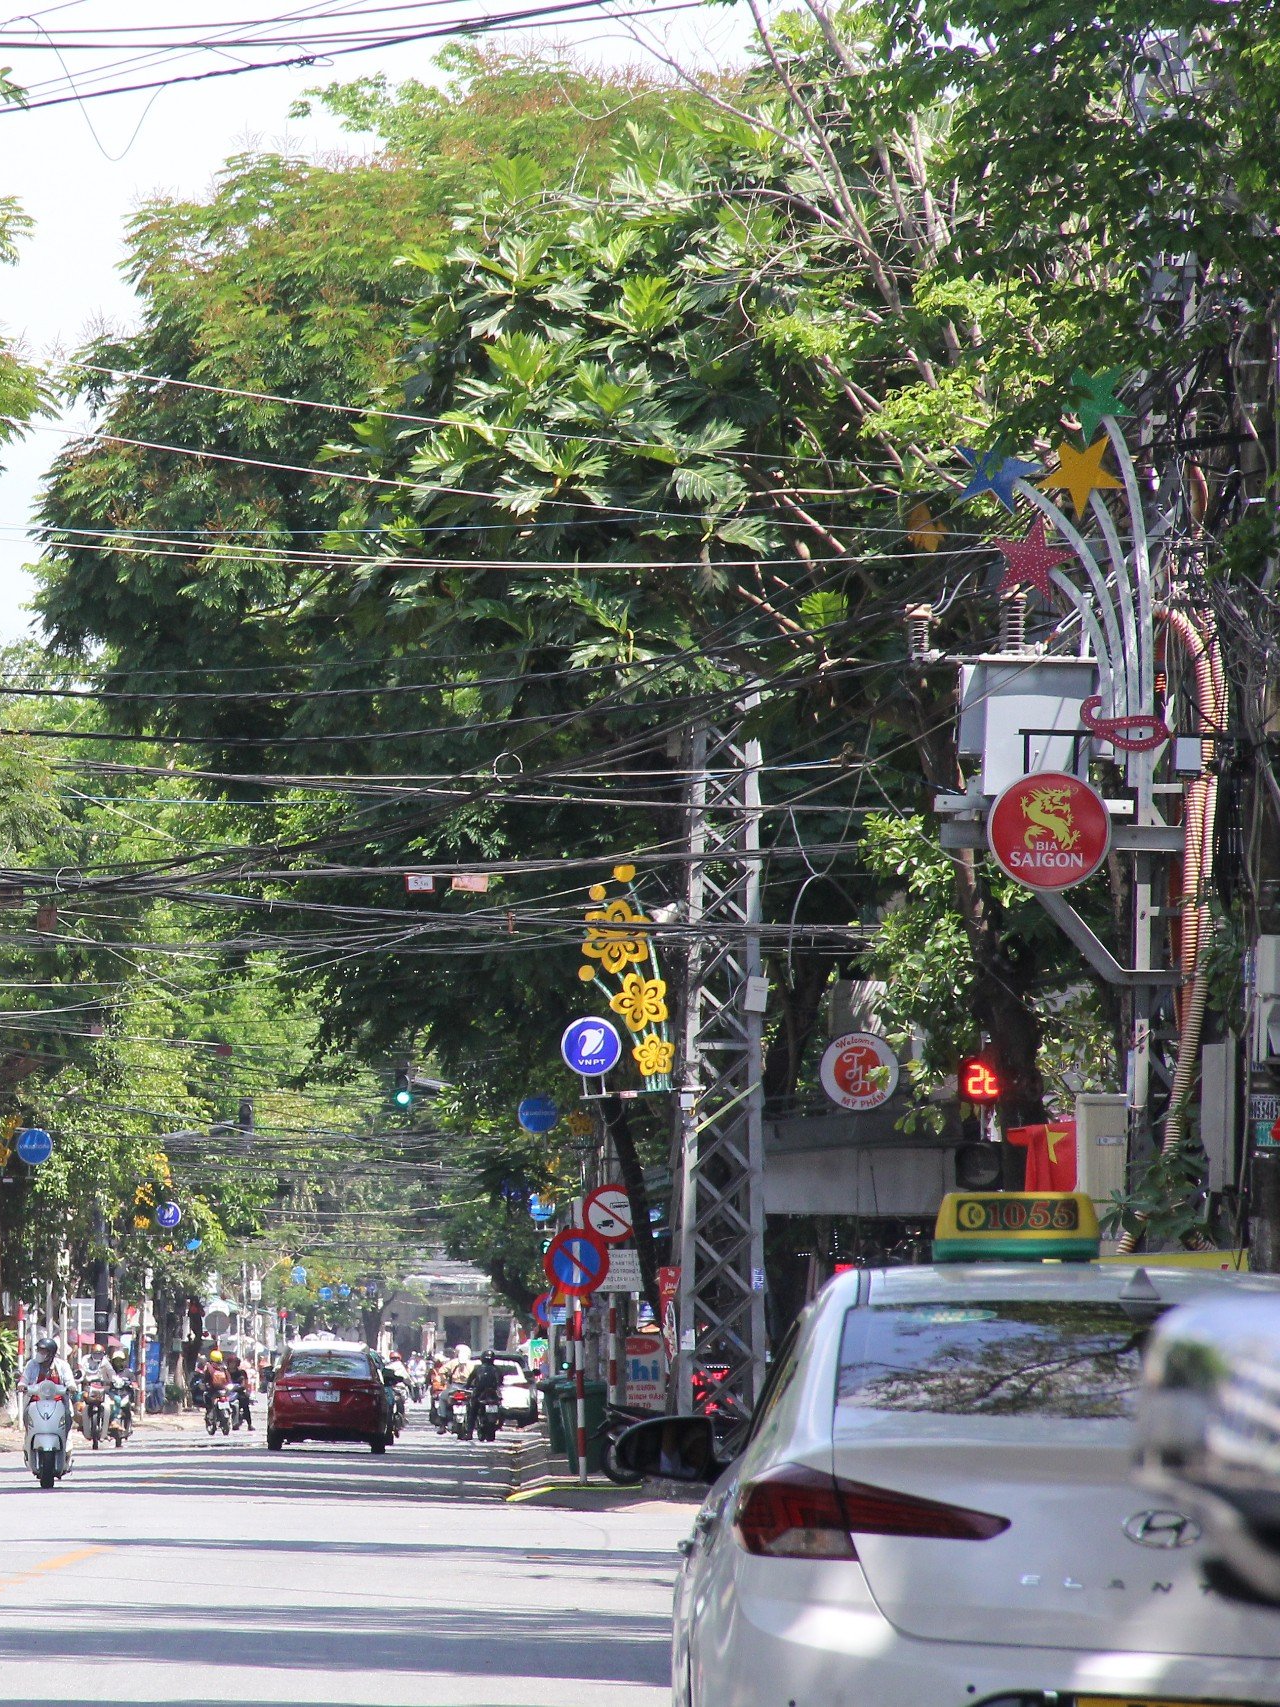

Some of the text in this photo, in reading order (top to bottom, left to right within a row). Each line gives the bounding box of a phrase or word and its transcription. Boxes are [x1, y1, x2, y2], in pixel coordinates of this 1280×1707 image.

[1035, 841, 1059, 851] BIA
[1009, 851, 1084, 868] SAIGON
[835, 1036, 875, 1049] Welcome
[578, 1058, 606, 1066] VNPT
[987, 1201, 1076, 1229] 1055
